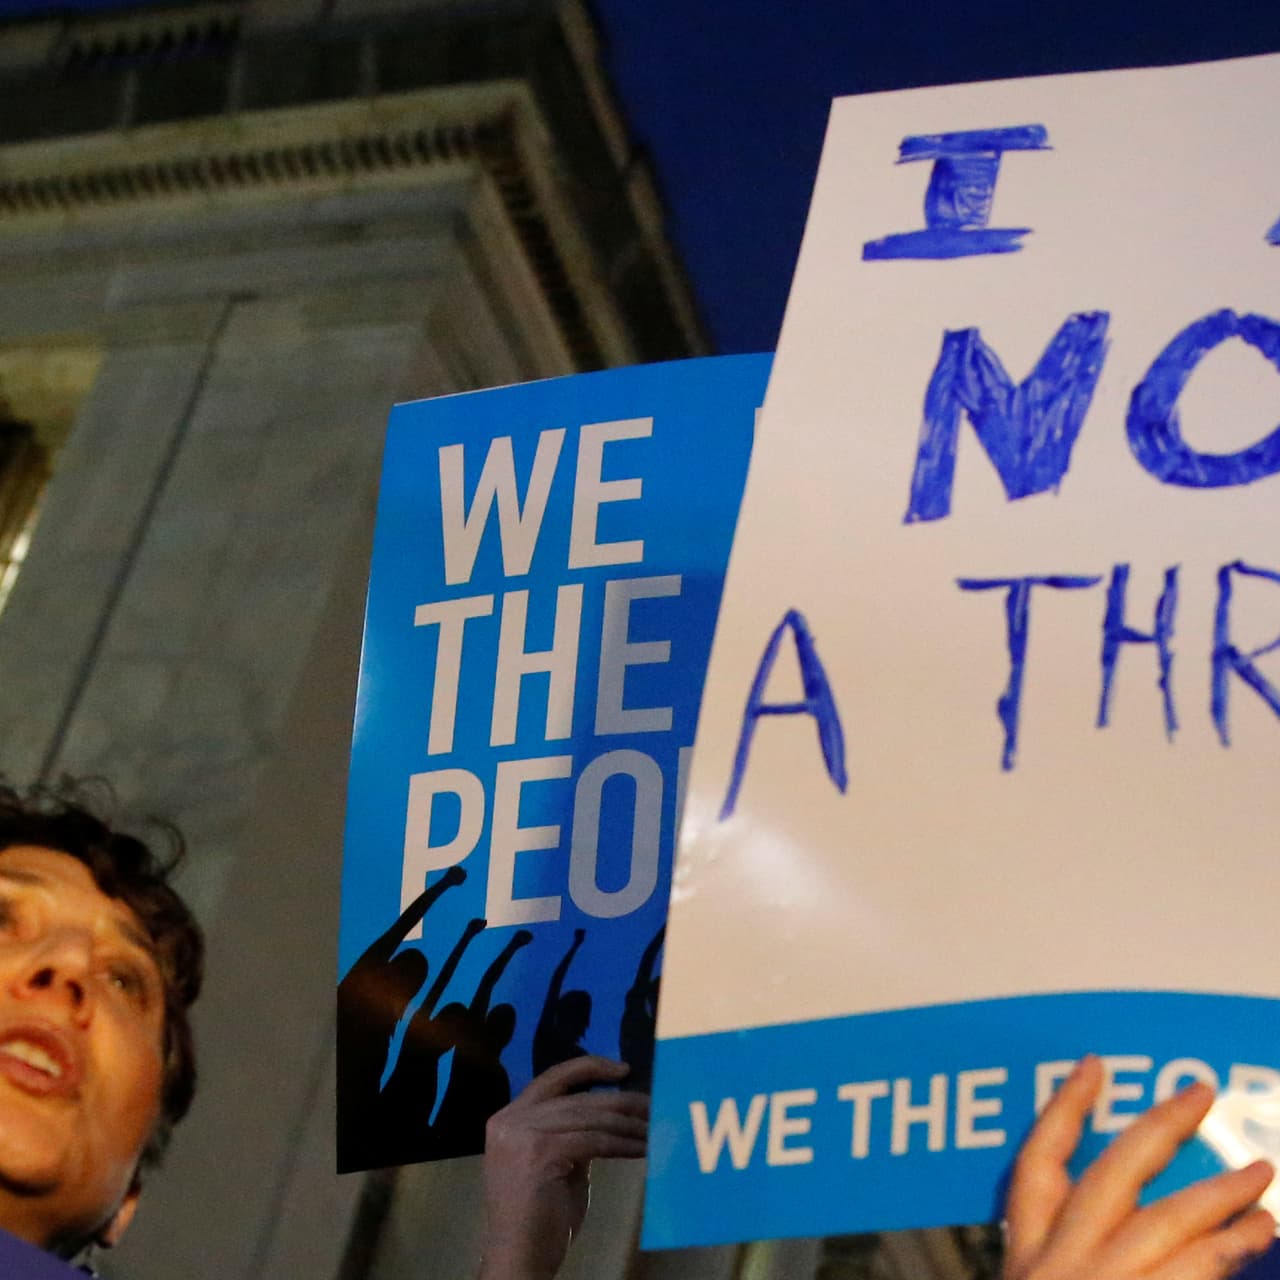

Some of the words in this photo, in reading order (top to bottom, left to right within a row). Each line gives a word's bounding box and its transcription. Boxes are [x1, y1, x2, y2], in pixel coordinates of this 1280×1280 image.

[861, 123, 1054, 262] I
[437, 416, 654, 586] WE
[413, 574, 683, 757] THE
[718, 609, 848, 823] A
[400, 745, 695, 942] PEO
[690, 1089, 818, 1173] WE
[838, 1067, 1007, 1158] THE
